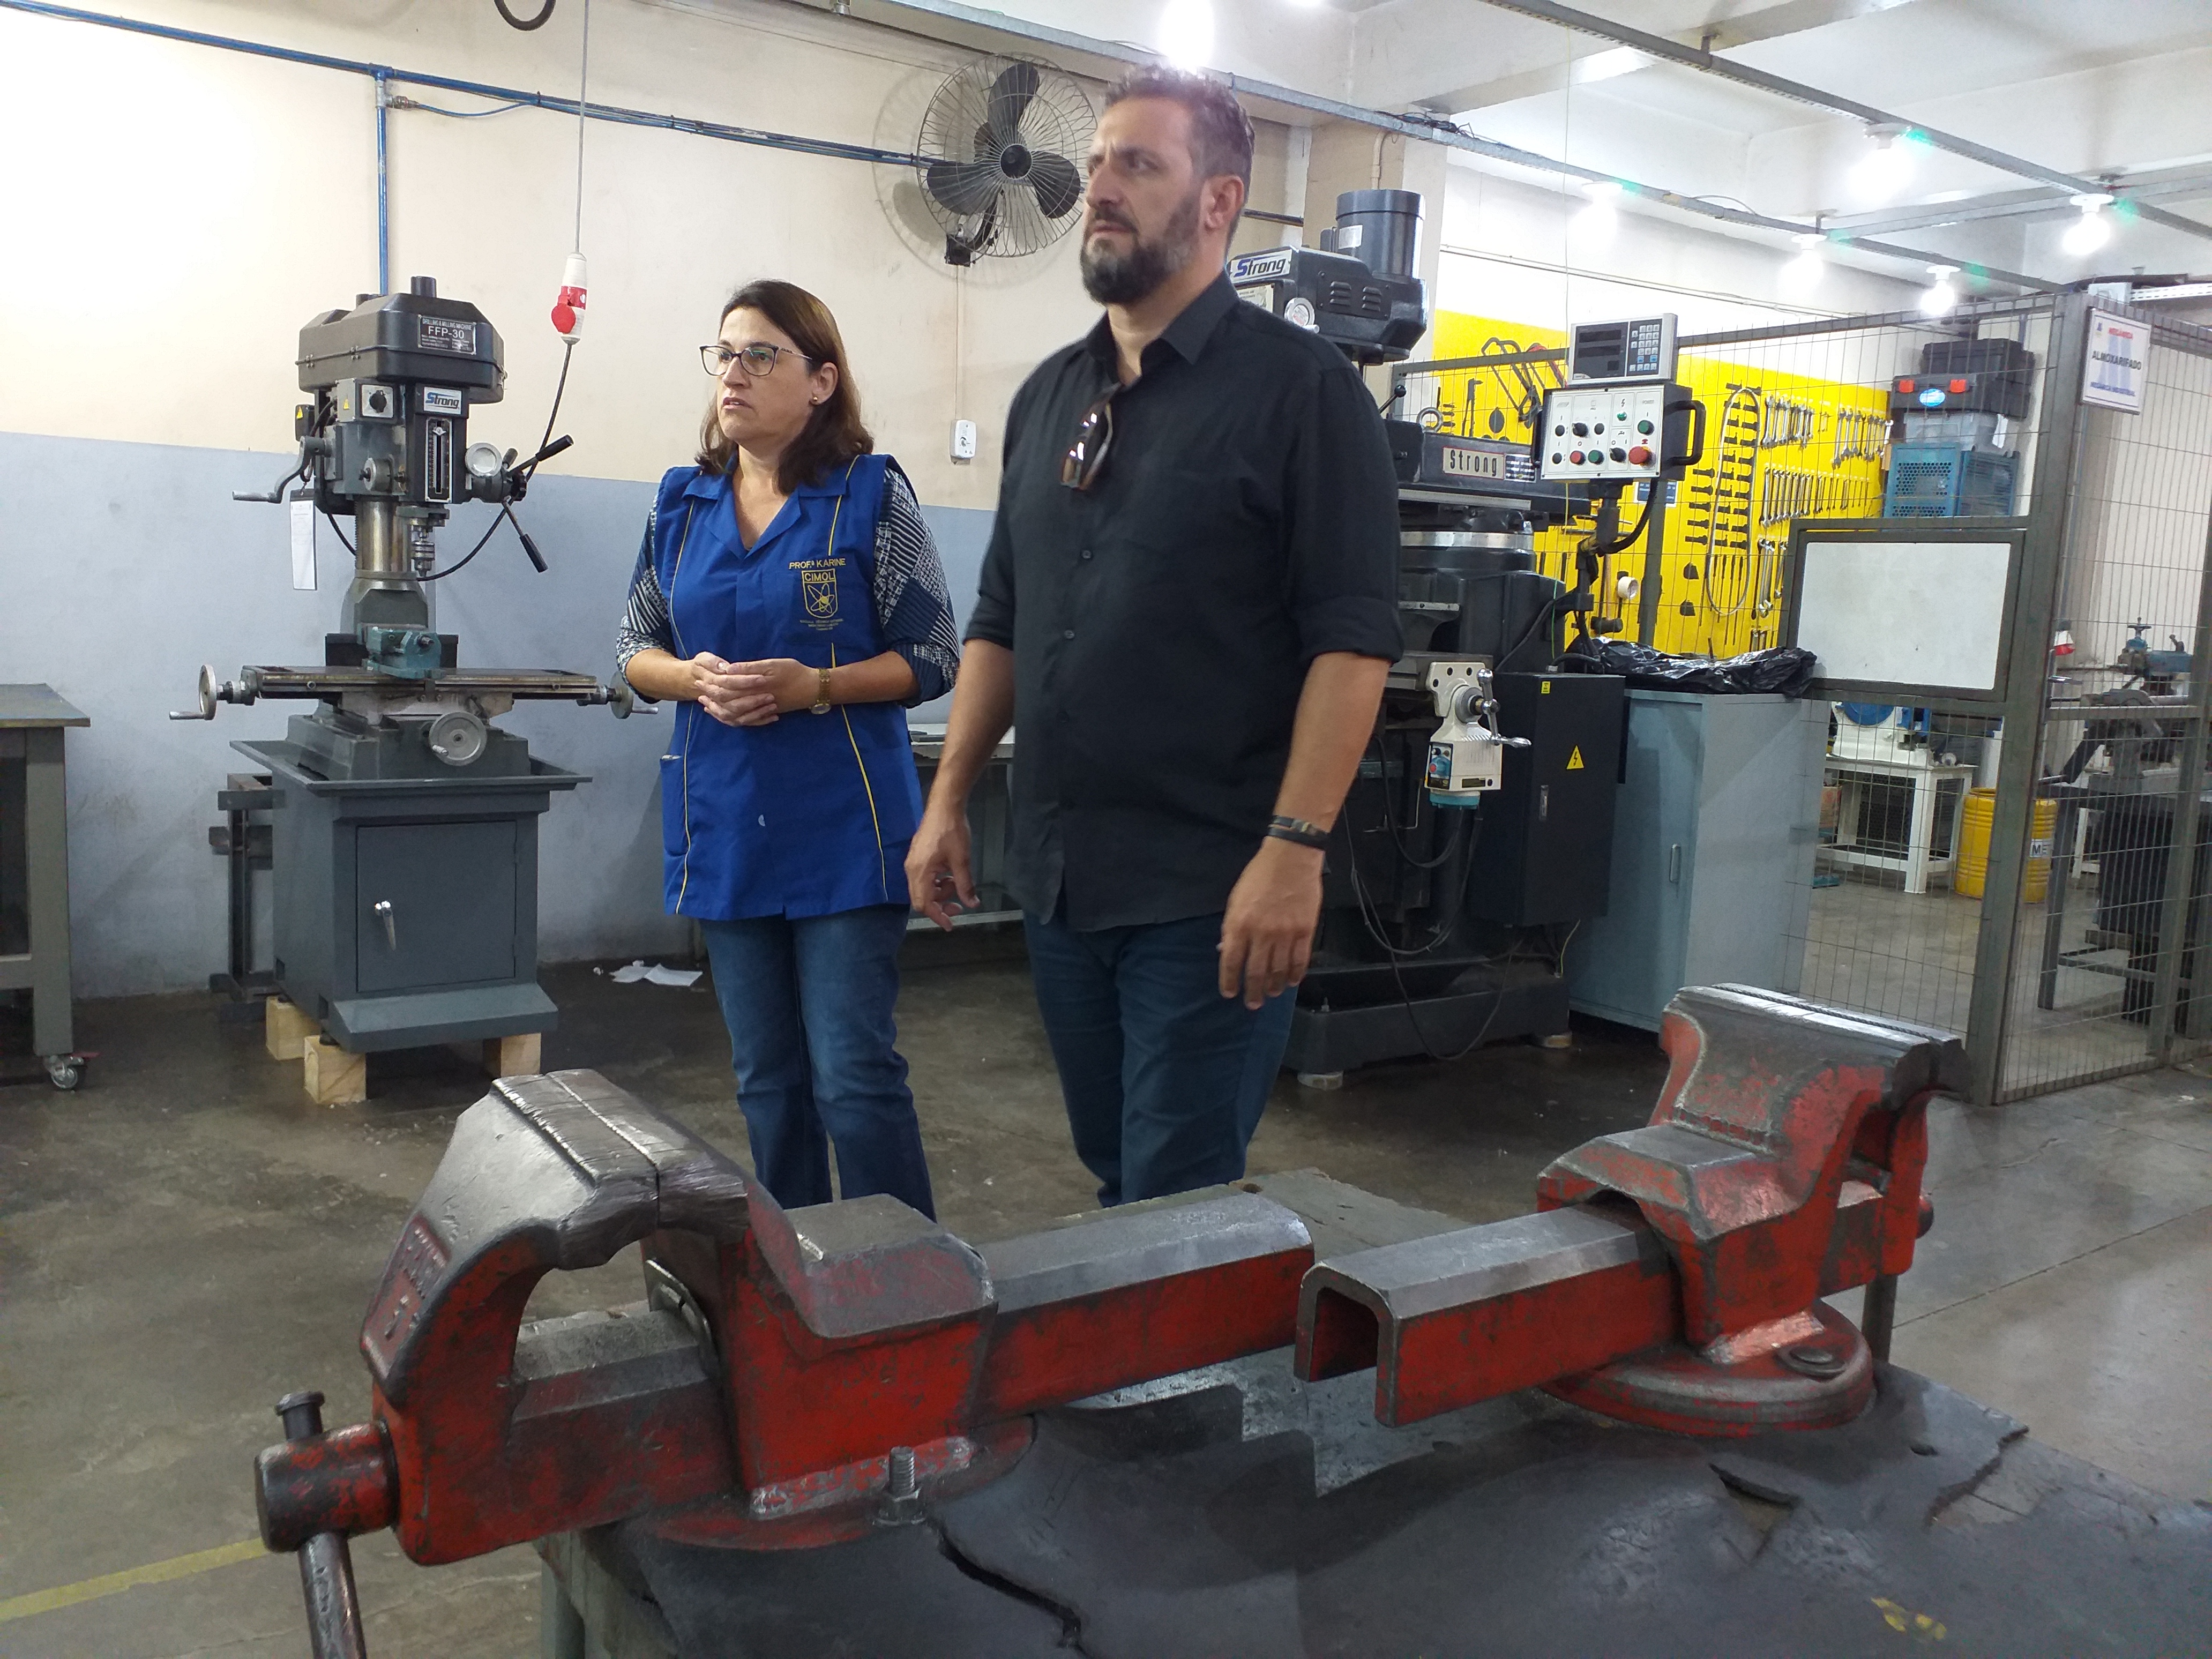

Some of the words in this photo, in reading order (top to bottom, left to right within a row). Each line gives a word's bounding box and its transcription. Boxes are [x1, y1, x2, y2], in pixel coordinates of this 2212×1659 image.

[1234, 258, 1286, 278] Strong
[422, 318, 438, 326] DRILLING
[428, 325, 465, 339] FFP-30
[425, 392, 460, 409] Strong
[1449, 449, 1498, 476] Strong
[816, 558, 846, 567] KARINE
[804, 572, 834, 581] CIMOL
